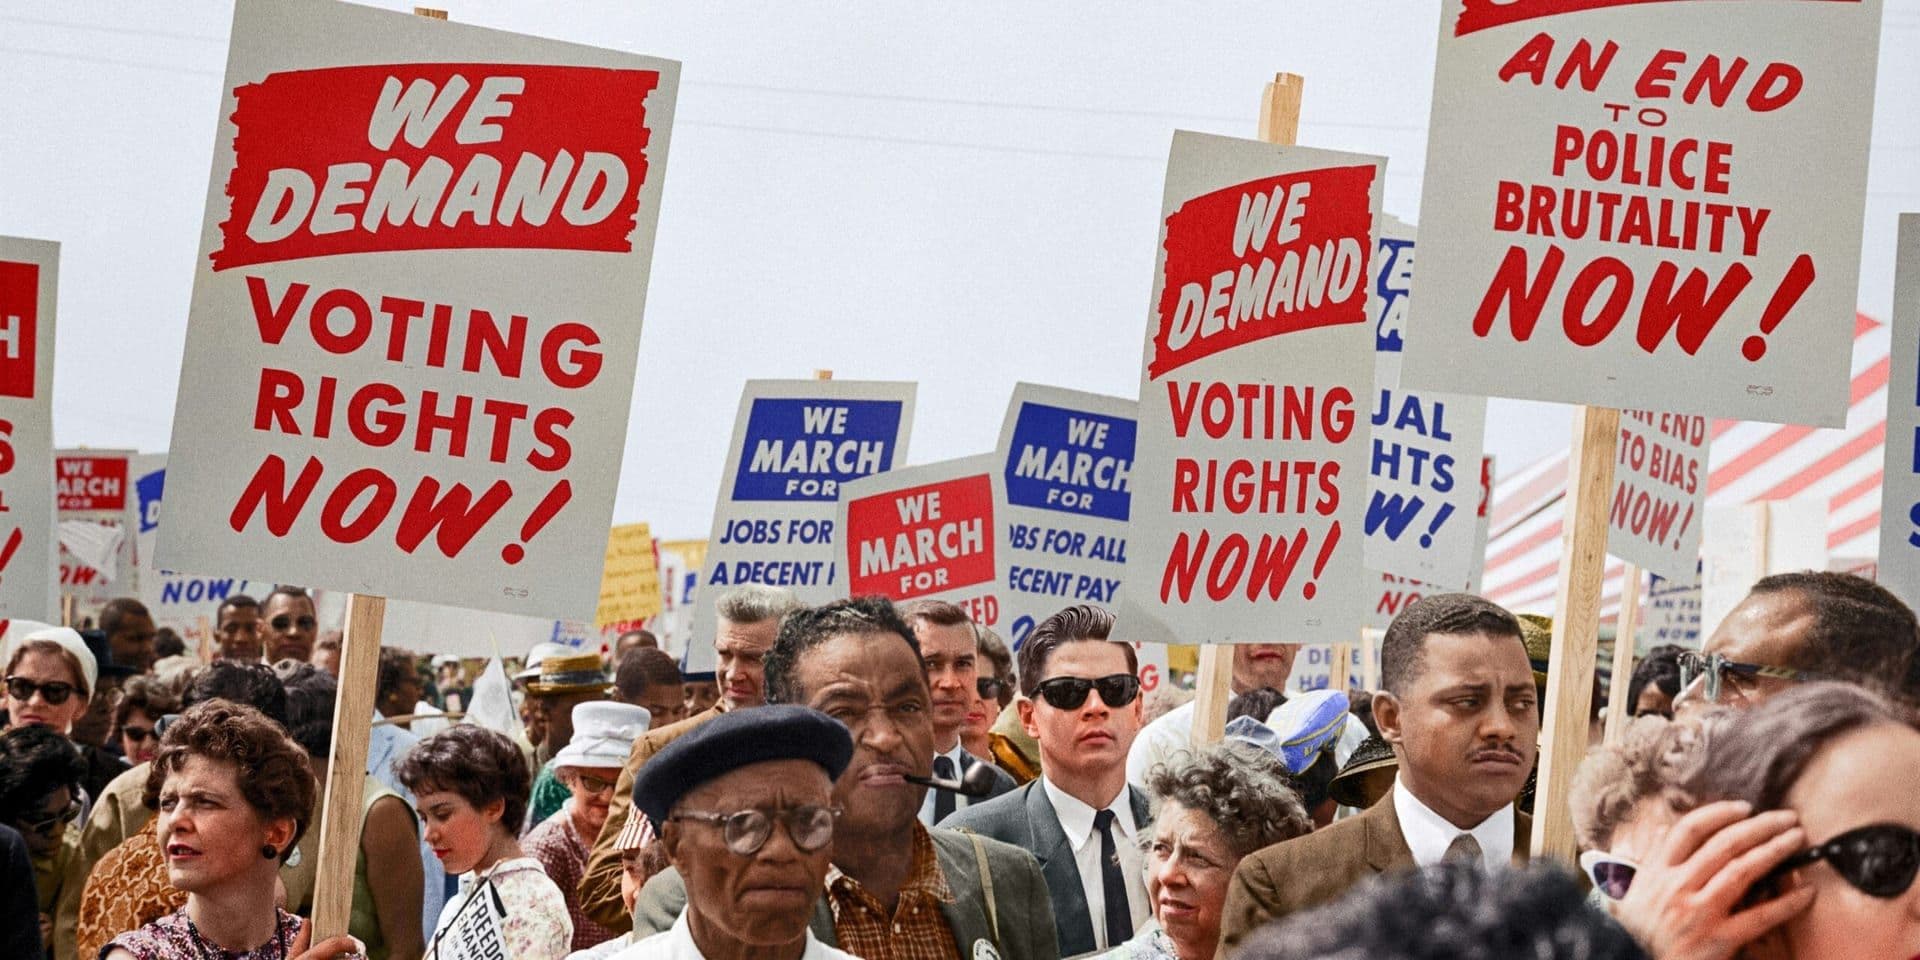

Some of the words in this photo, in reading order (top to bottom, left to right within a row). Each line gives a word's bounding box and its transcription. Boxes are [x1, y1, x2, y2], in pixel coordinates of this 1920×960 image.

[1498, 32, 1619, 92] AN
[1635, 50, 1803, 112] END
[366, 74, 525, 151] WE
[1604, 103, 1668, 127] TO
[1553, 124, 1733, 194] POLICE
[245, 149, 630, 243] DEMAND
[1232, 182, 1310, 258] WE
[1494, 181, 1772, 257] BRUTALITY
[1166, 238, 1361, 351] DEMAND
[1472, 244, 1816, 362] NOW!
[245, 276, 603, 389] VOTING
[253, 368, 575, 472] RIGHTS
[803, 407, 848, 434] WE
[1068, 418, 1109, 449] WE
[1167, 381, 1355, 444] VOTING
[62, 460, 93, 476] WE
[750, 440, 884, 474] MARCH
[1015, 444, 1134, 492] MARCH
[1371, 439, 1455, 493] HTS
[1620, 428, 1645, 472] TO
[1649, 443, 1698, 495] BIAS
[58, 477, 120, 496] ARCH
[229, 454, 572, 565] NOW!
[785, 480, 837, 495] FOR
[896, 491, 941, 525] WE
[1047, 489, 1093, 509] FOR
[1172, 459, 1340, 516] RIGHTS
[720, 520, 782, 543] JOBS
[787, 520, 833, 543] FOR
[1610, 480, 1694, 551] NOW!
[709, 562, 728, 585] A
[734, 562, 823, 585] DECENT
[860, 518, 983, 577] MARCH
[1042, 528, 1086, 557] FOR
[1088, 536, 1126, 564] ALL
[1160, 520, 1341, 604] NOW!
[900, 568, 948, 594] FOR
[1009, 566, 1073, 596] ECENT
[1075, 575, 1120, 603] PAY
